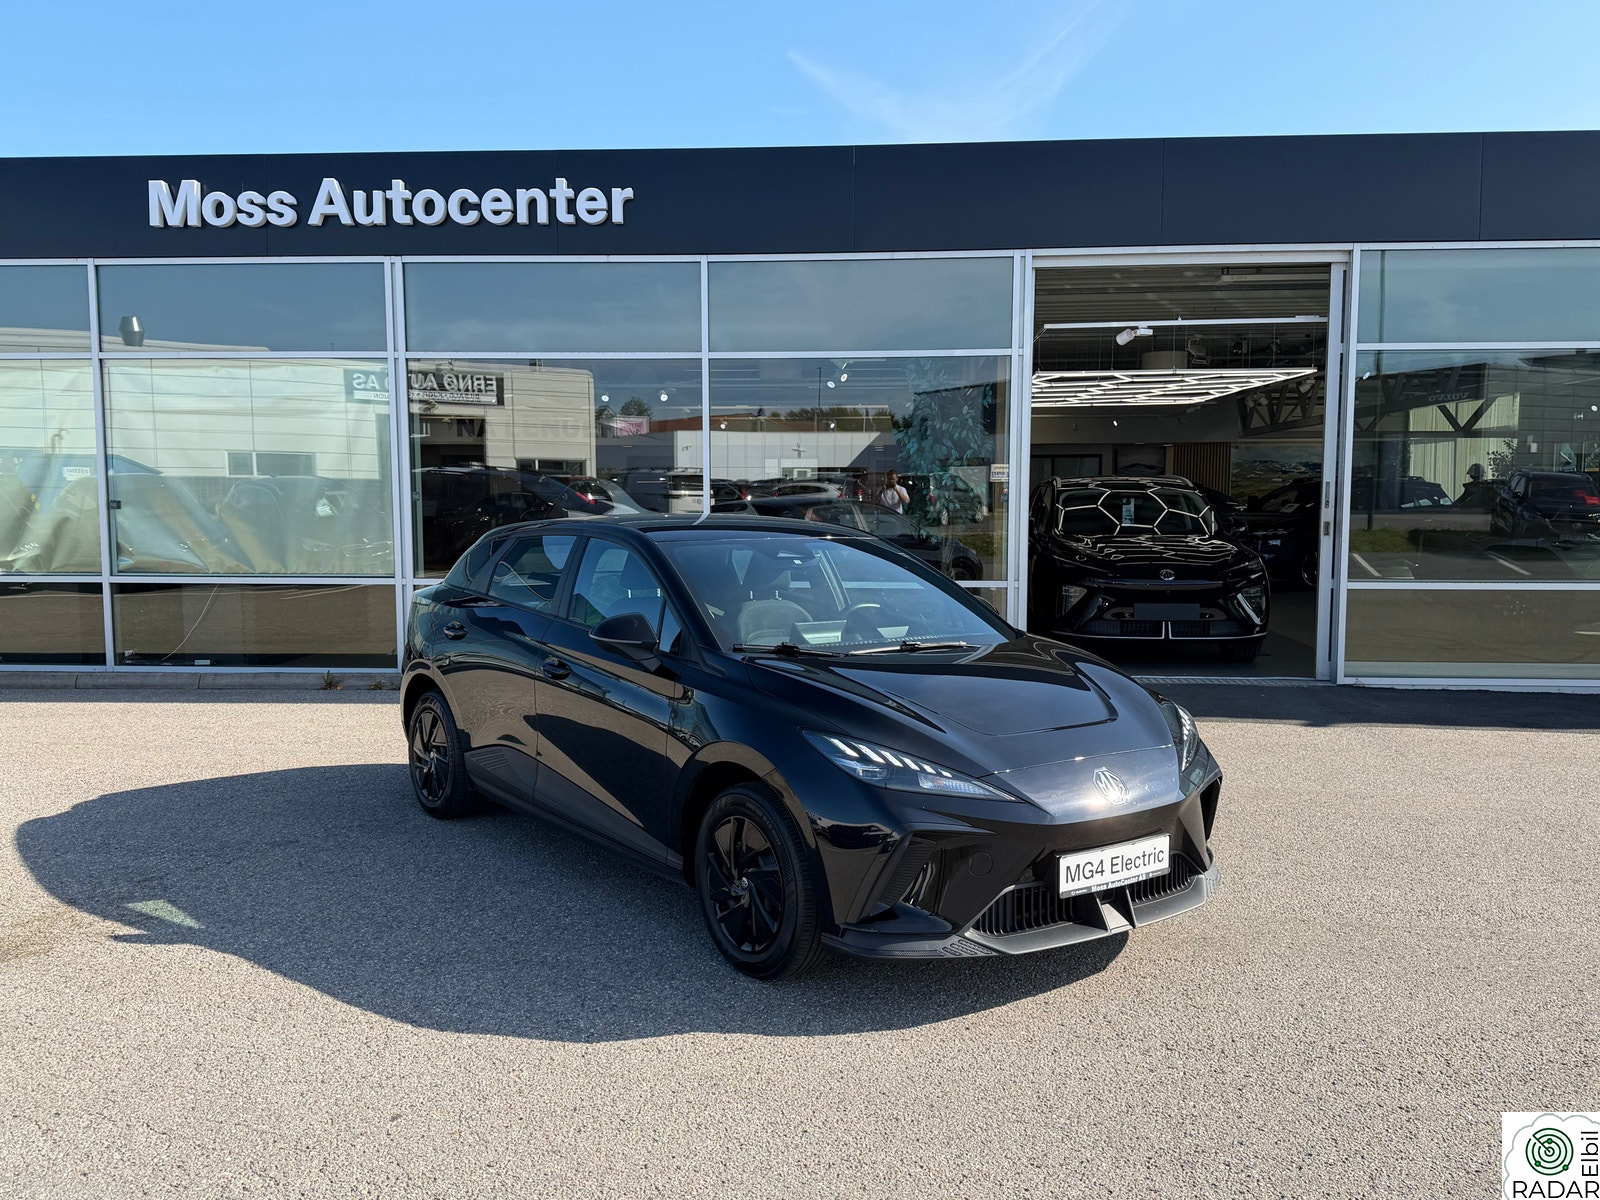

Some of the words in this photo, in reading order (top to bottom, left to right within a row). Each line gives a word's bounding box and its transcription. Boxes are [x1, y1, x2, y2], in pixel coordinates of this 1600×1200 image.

[147, 178, 298, 228] Moss
[306, 176, 634, 227] Autocenter
[1065, 859, 1105, 884] MG4
[1110, 847, 1164, 875] Electric
[1091, 884, 1107, 893] Moss
